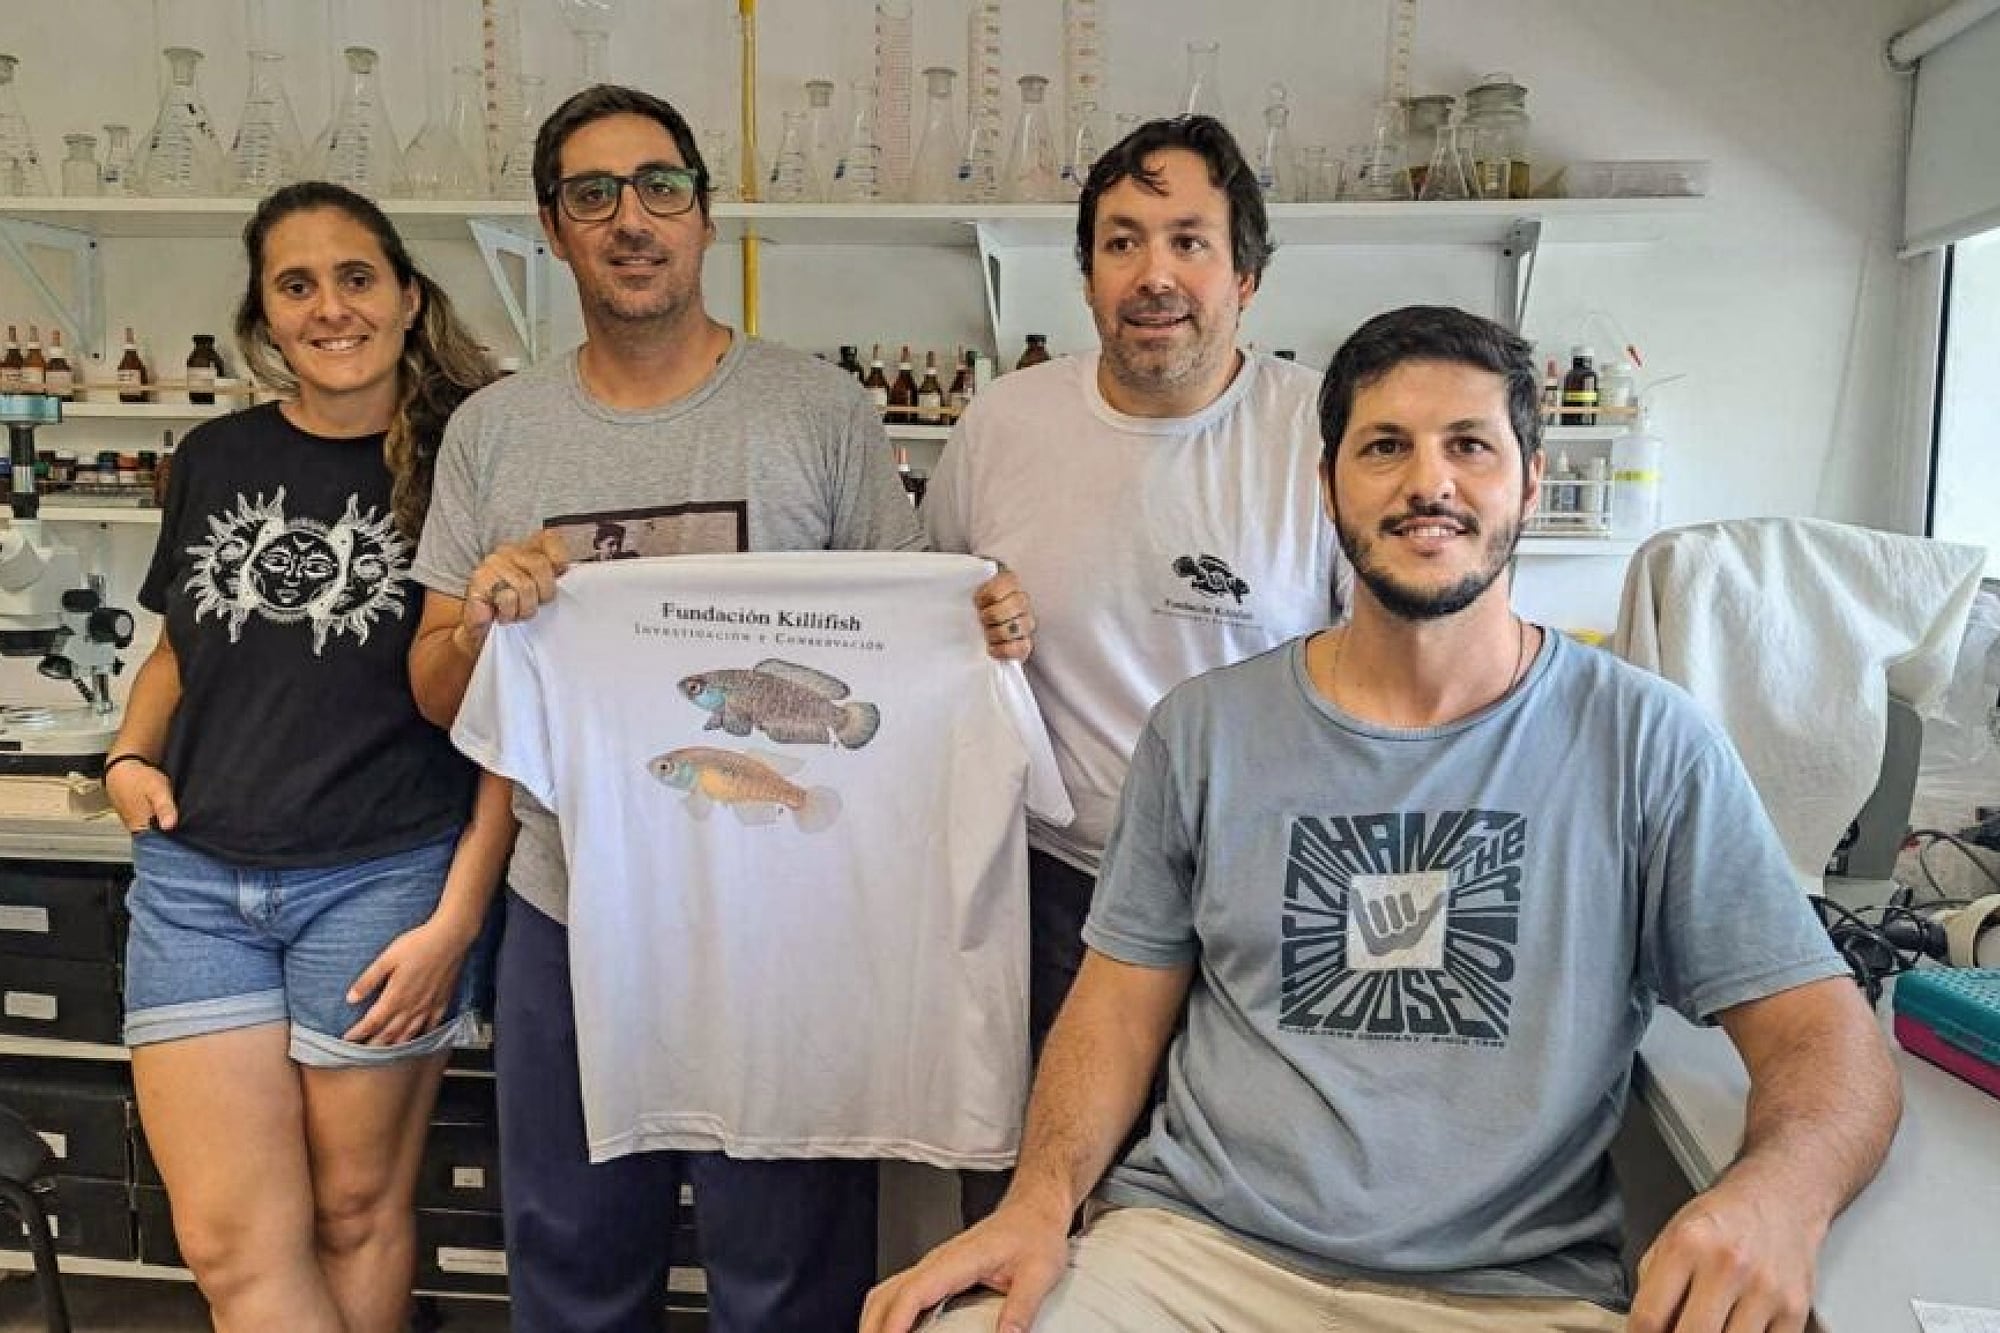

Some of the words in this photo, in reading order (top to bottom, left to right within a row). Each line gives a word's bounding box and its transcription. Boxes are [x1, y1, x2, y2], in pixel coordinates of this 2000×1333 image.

[662, 602, 770, 626] Fundación
[777, 608, 861, 631] Killifish
[1298, 808, 1521, 874] HANG
[1278, 969, 1502, 1038] LOOSE
